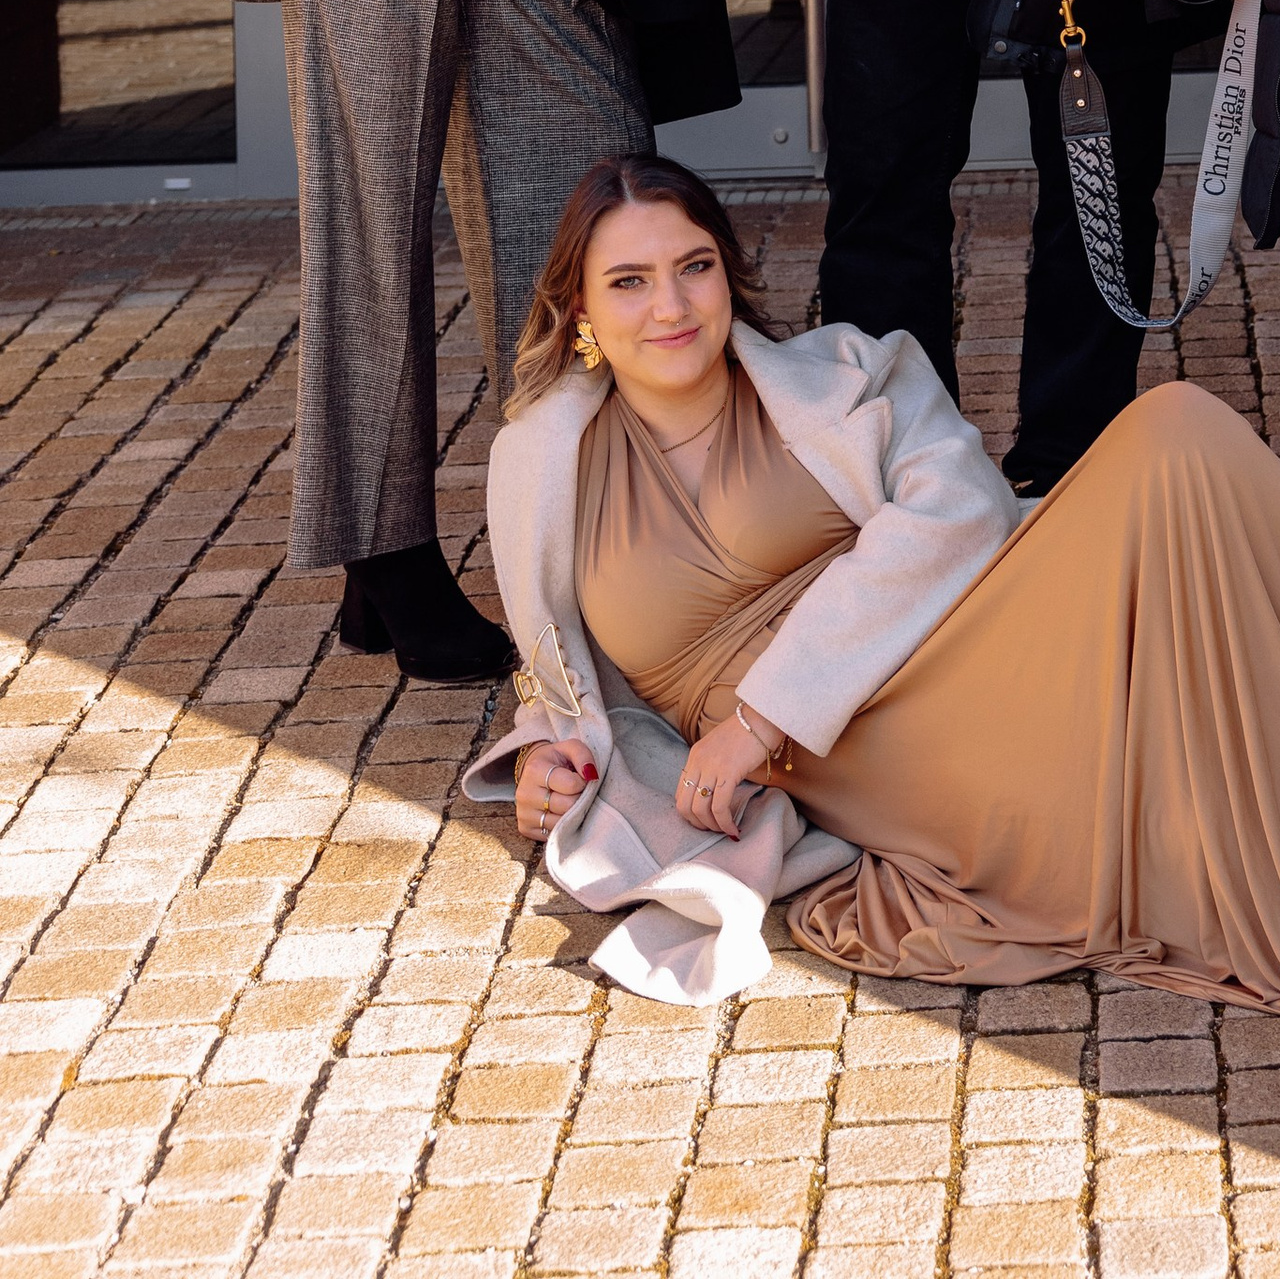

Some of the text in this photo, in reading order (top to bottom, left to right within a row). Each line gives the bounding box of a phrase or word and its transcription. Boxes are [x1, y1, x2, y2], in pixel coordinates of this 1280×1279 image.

[1203, 22, 1247, 196] Christian Dior
[1233, 88, 1247, 136] PARIS
